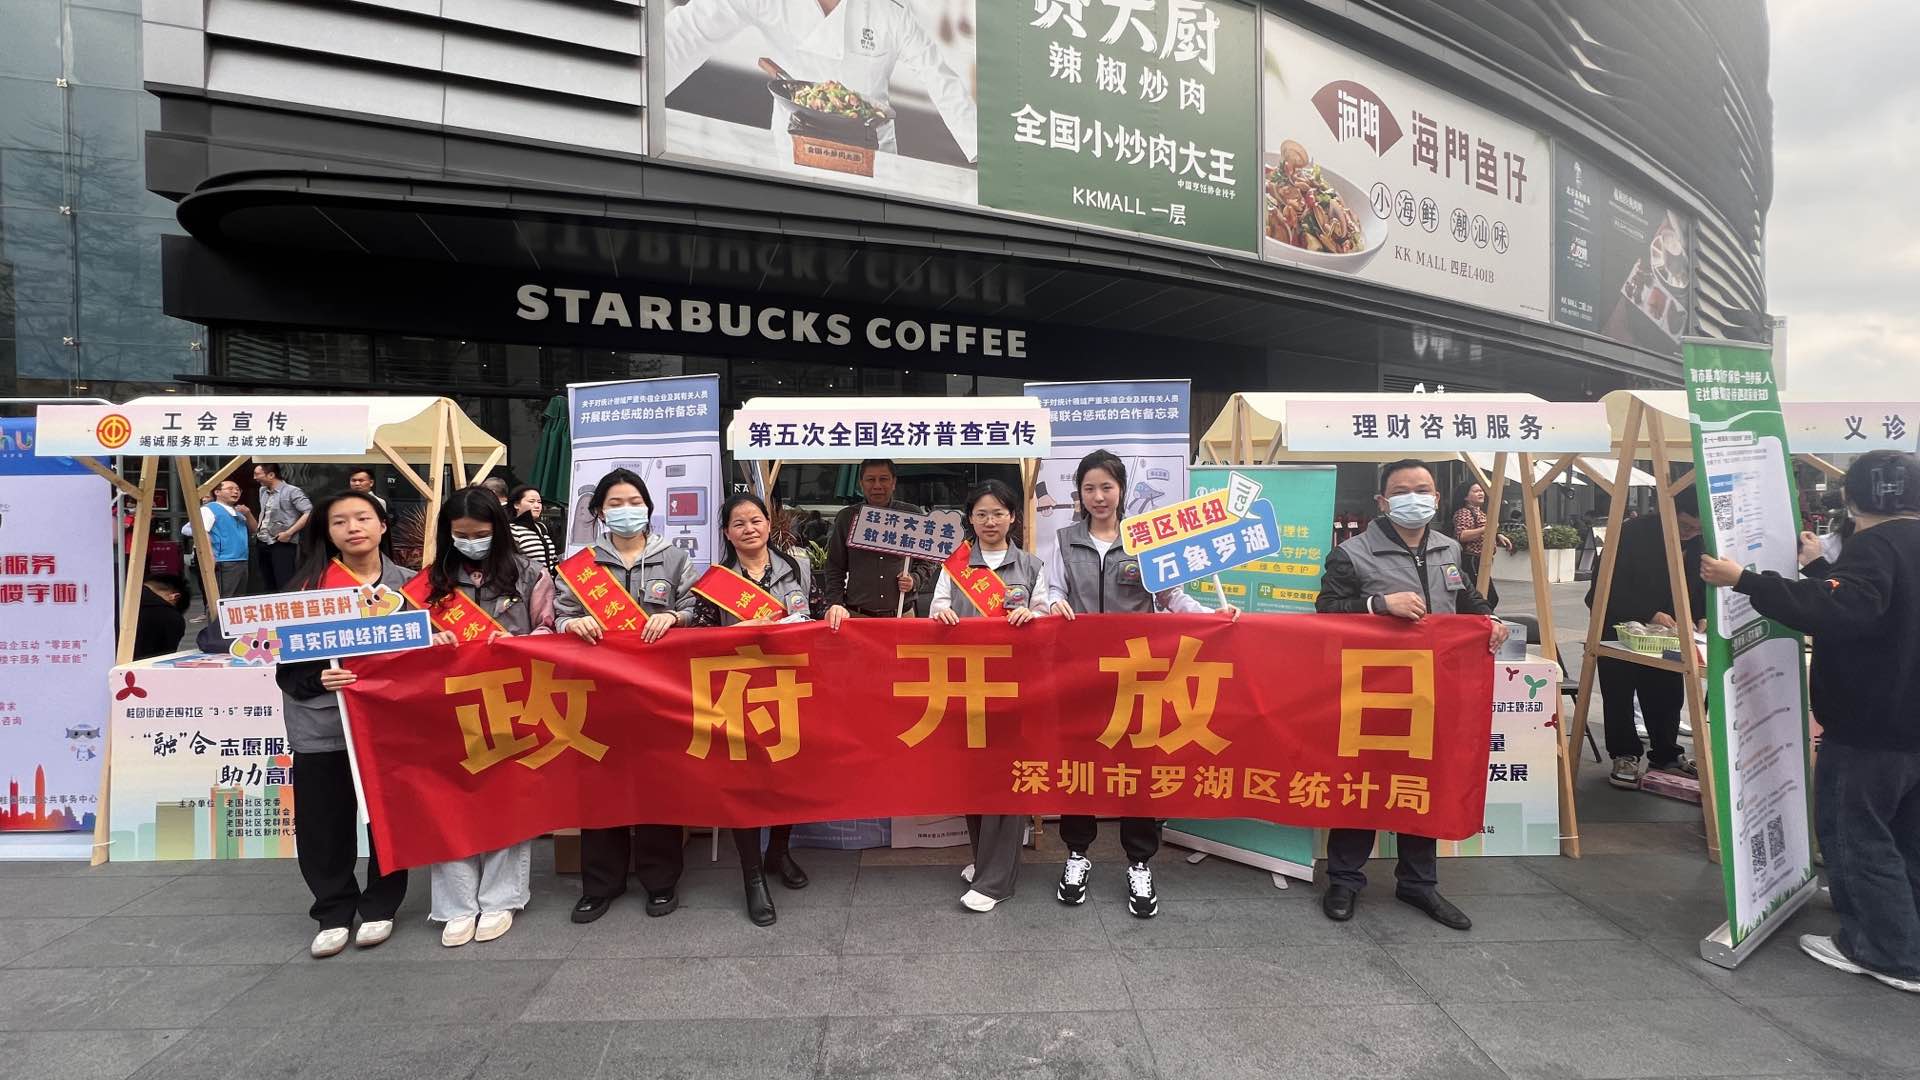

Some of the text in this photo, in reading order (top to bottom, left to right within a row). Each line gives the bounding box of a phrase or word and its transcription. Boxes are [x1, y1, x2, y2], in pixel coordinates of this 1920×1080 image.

[1049, 42, 1206, 115] 辣椒炒肉
[1011, 104, 1236, 186] 全国小炒肉大王
[1073, 186, 1187, 226] KKMALL 一层
[1370, 181, 1510, 254] 小海鲜 潮汕味
[1394, 245, 1412, 262] KK
[1416, 250, 1448, 273] MALL
[516, 284, 1027, 358] STARBUCKS COFFEE
[162, 411, 288, 432] 工会宣传
[580, 403, 708, 424] 开展联合惩戒的合作备忘录
[1352, 413, 1543, 440] 理财咨询服务
[1844, 414, 1907, 440] 义诊
[139, 434, 309, 447] 竭诚服务职工 忠诚党的事业
[749, 421, 1036, 447] 第五次全国经济普查宣传
[1234, 481, 1252, 513] call
[866, 511, 956, 539] 经济大普查
[1127, 498, 1227, 548] 湾区枢纽
[0, 554, 55, 576] 服务
[1152, 523, 1270, 583] 万象罗湖
[962, 567, 1013, 618] 诚信统
[227, 596, 352, 625] 如实填报普查资料
[289, 621, 422, 653] 真实反映经济全貌
[444, 635, 1435, 775] 政府开放日
[143, 731, 294, 757] “融”合志愿服
[219, 763, 1529, 786] 助力高 发展
[1011, 760, 1431, 815] 深圳市罗湖区统计局
